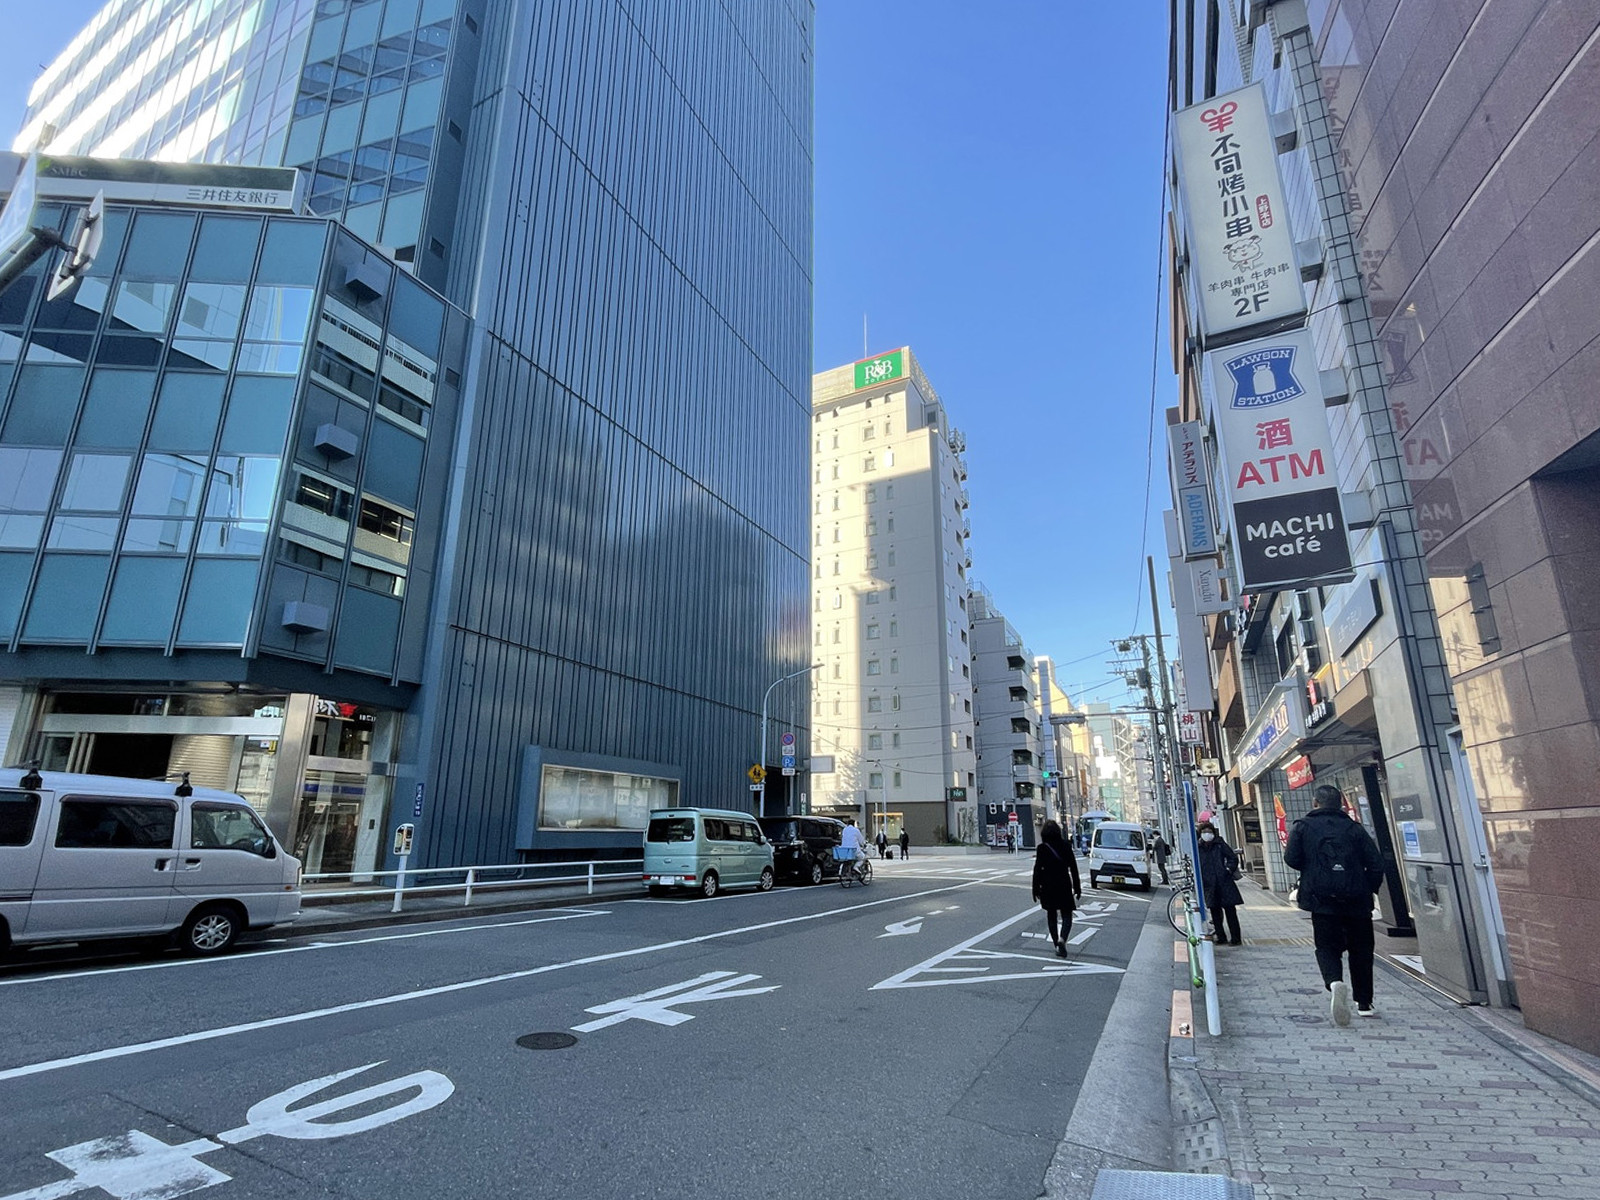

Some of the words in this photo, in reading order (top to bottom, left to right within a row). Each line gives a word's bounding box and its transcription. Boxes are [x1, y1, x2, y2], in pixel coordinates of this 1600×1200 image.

[186, 187, 279, 205] 三井住友銀行
[1233, 290, 1270, 318] 2F
[864, 359, 893, 380] R&B
[1229, 348, 1291, 370] LAWSON
[1236, 386, 1297, 407] STATION
[1256, 418, 1294, 451] 酒
[1181, 441, 1198, 484] アデランス
[1236, 448, 1326, 490] ATM
[1185, 493, 1209, 549] ADERANS
[1245, 512, 1335, 542] MACHI
[1264, 535, 1322, 559] café
[1182, 713, 1197, 740] 桃山
